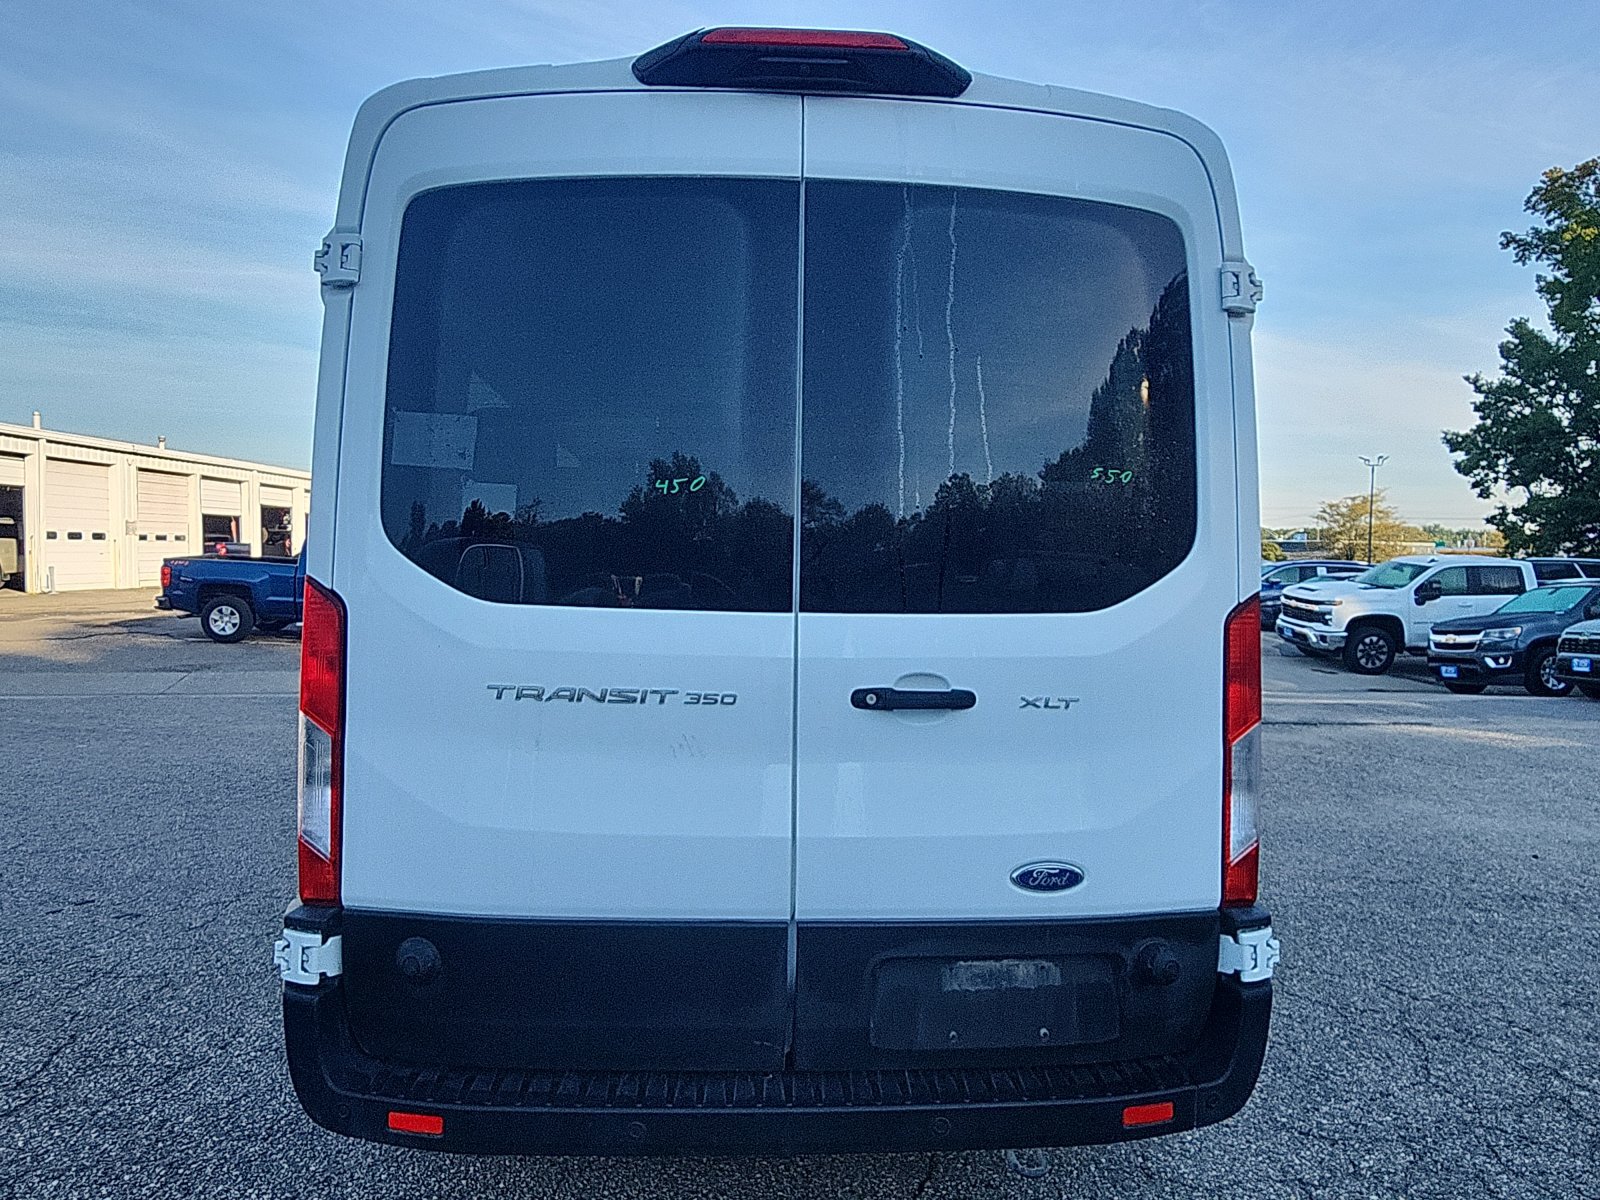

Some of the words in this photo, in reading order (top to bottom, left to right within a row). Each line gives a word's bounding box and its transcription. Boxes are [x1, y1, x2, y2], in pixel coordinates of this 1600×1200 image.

[655, 475, 706, 495] 450
[486, 684, 679, 706] TRANSIT
[683, 692, 738, 706] 350
[1019, 695, 1080, 710] XLT
[1028, 868, 1071, 886] Ford
